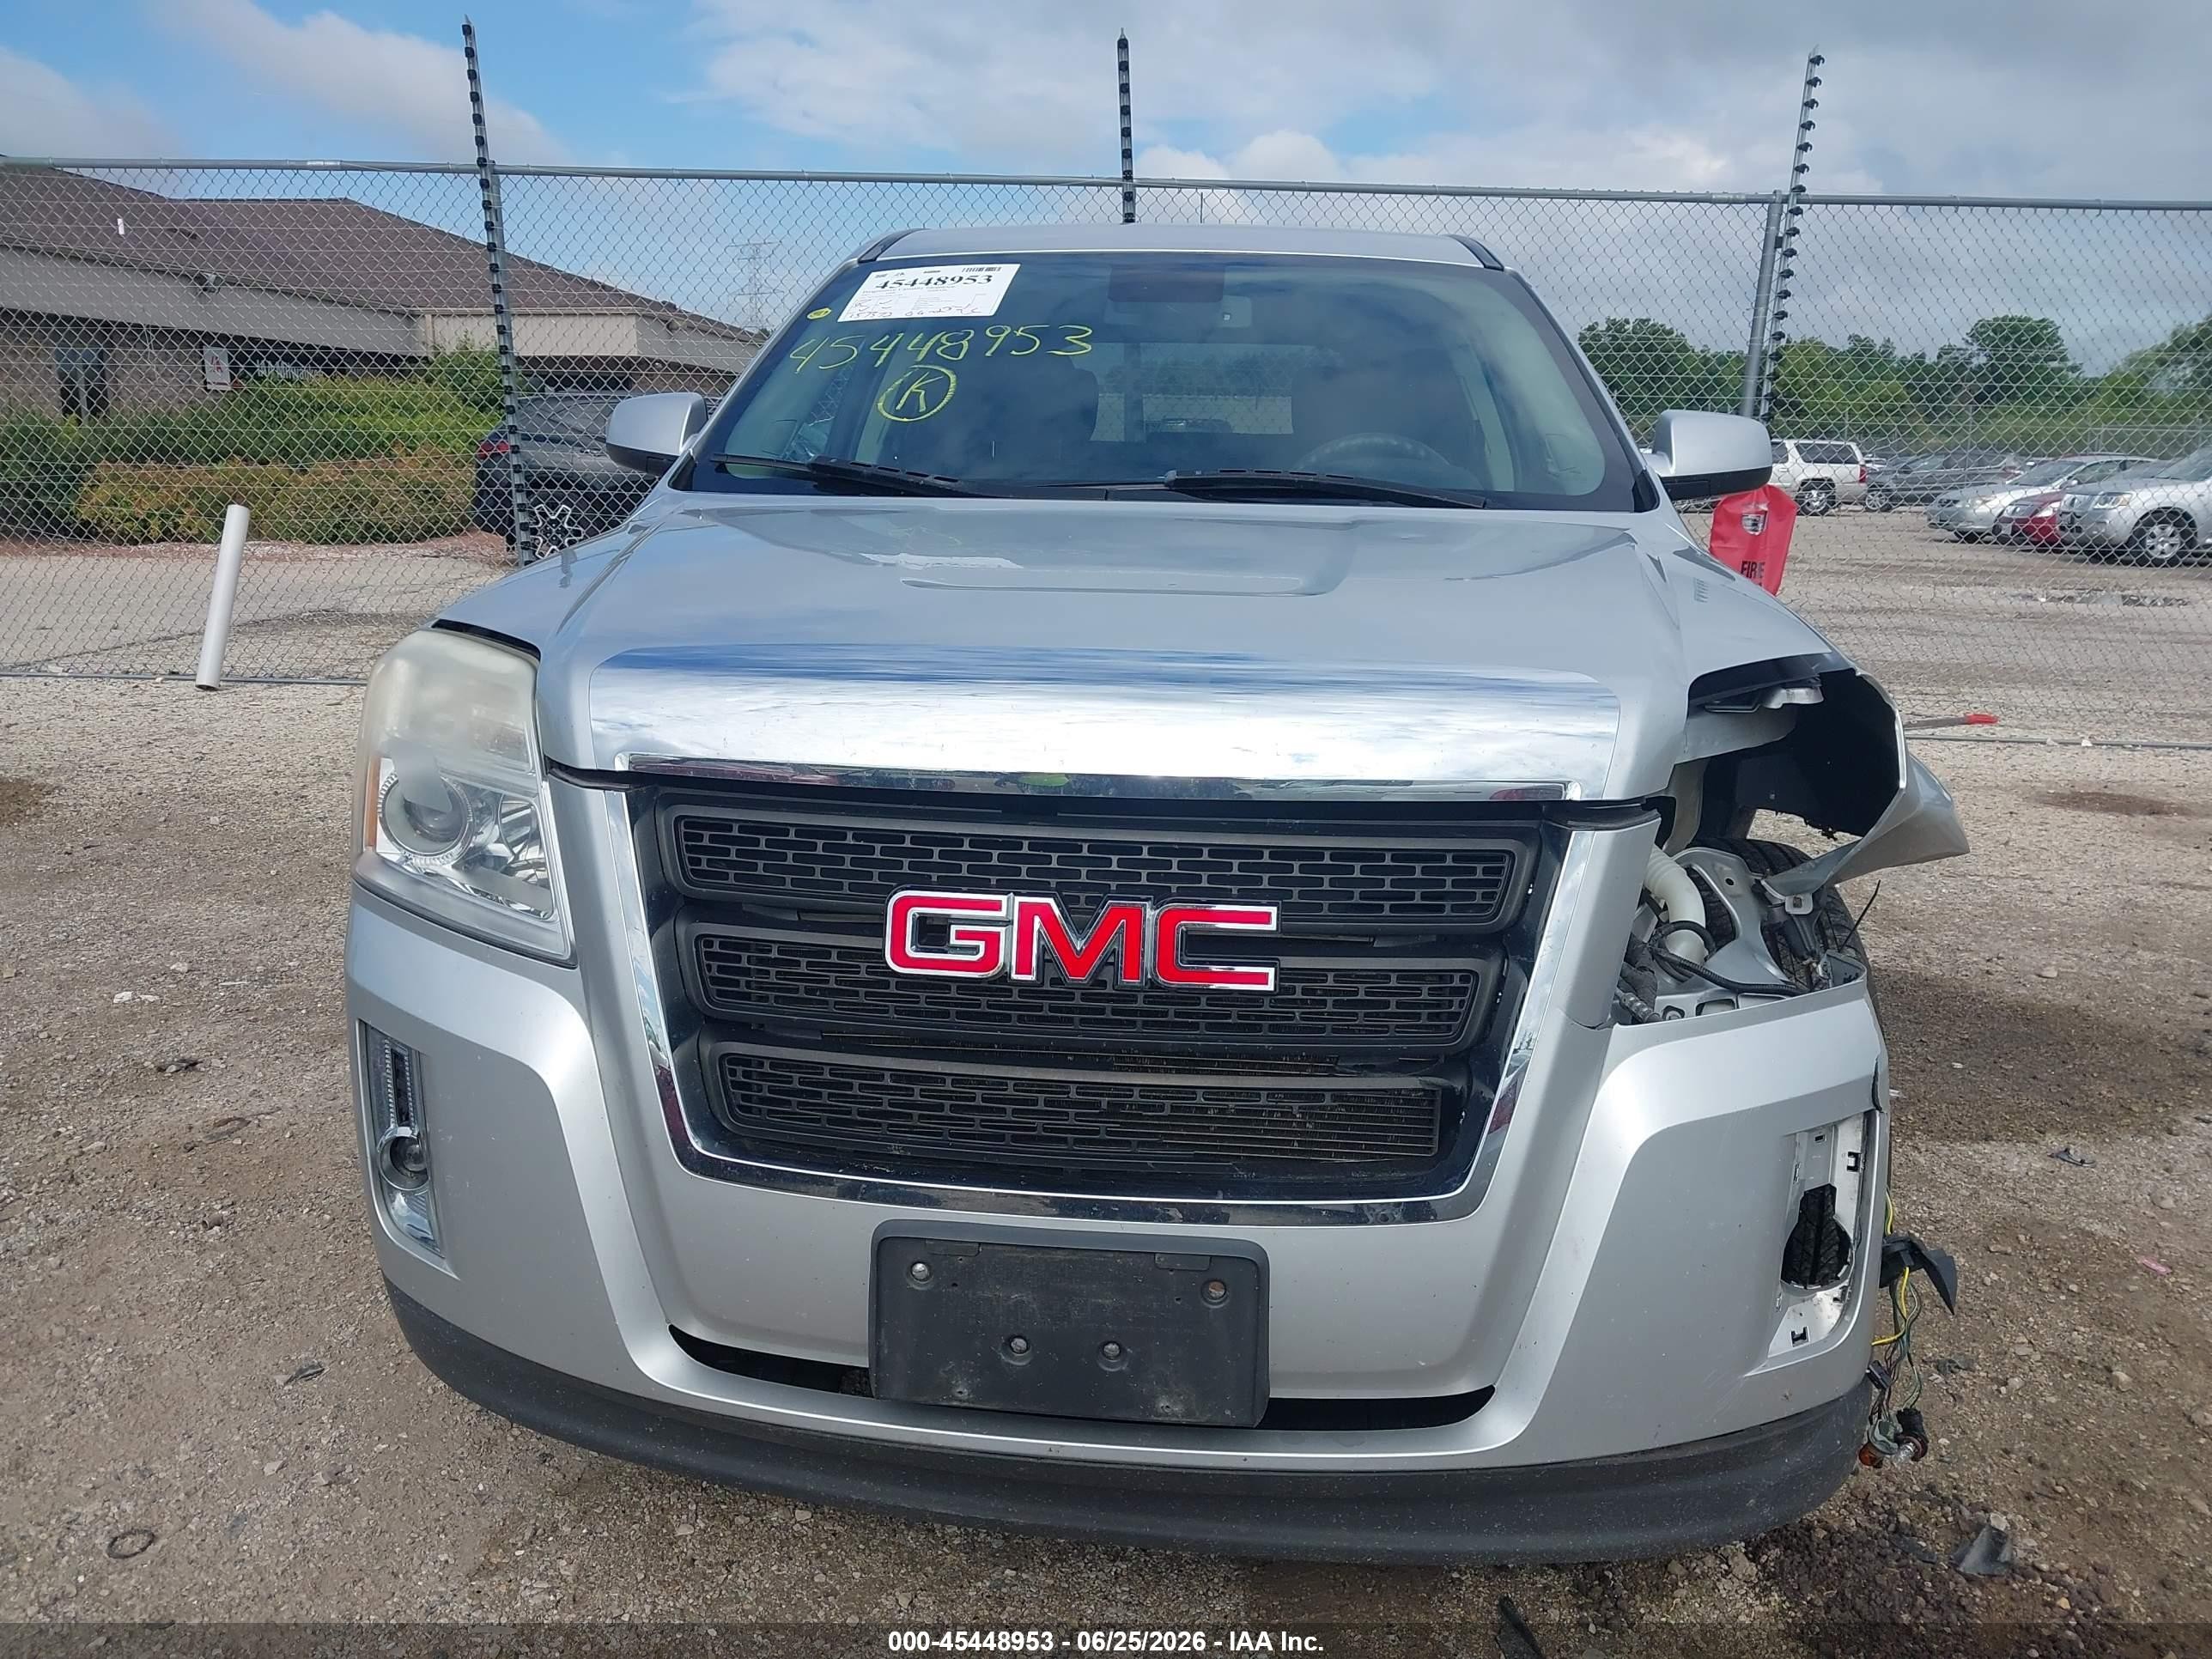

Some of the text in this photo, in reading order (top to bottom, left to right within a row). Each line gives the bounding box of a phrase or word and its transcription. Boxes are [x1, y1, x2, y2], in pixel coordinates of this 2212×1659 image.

[877, 274, 993, 289] 45448953
[789, 324, 1094, 374] 45448953
[895, 372, 946, 413] K
[1741, 561, 1765, 579] FIRE
[885, 890, 1279, 992] GMC
